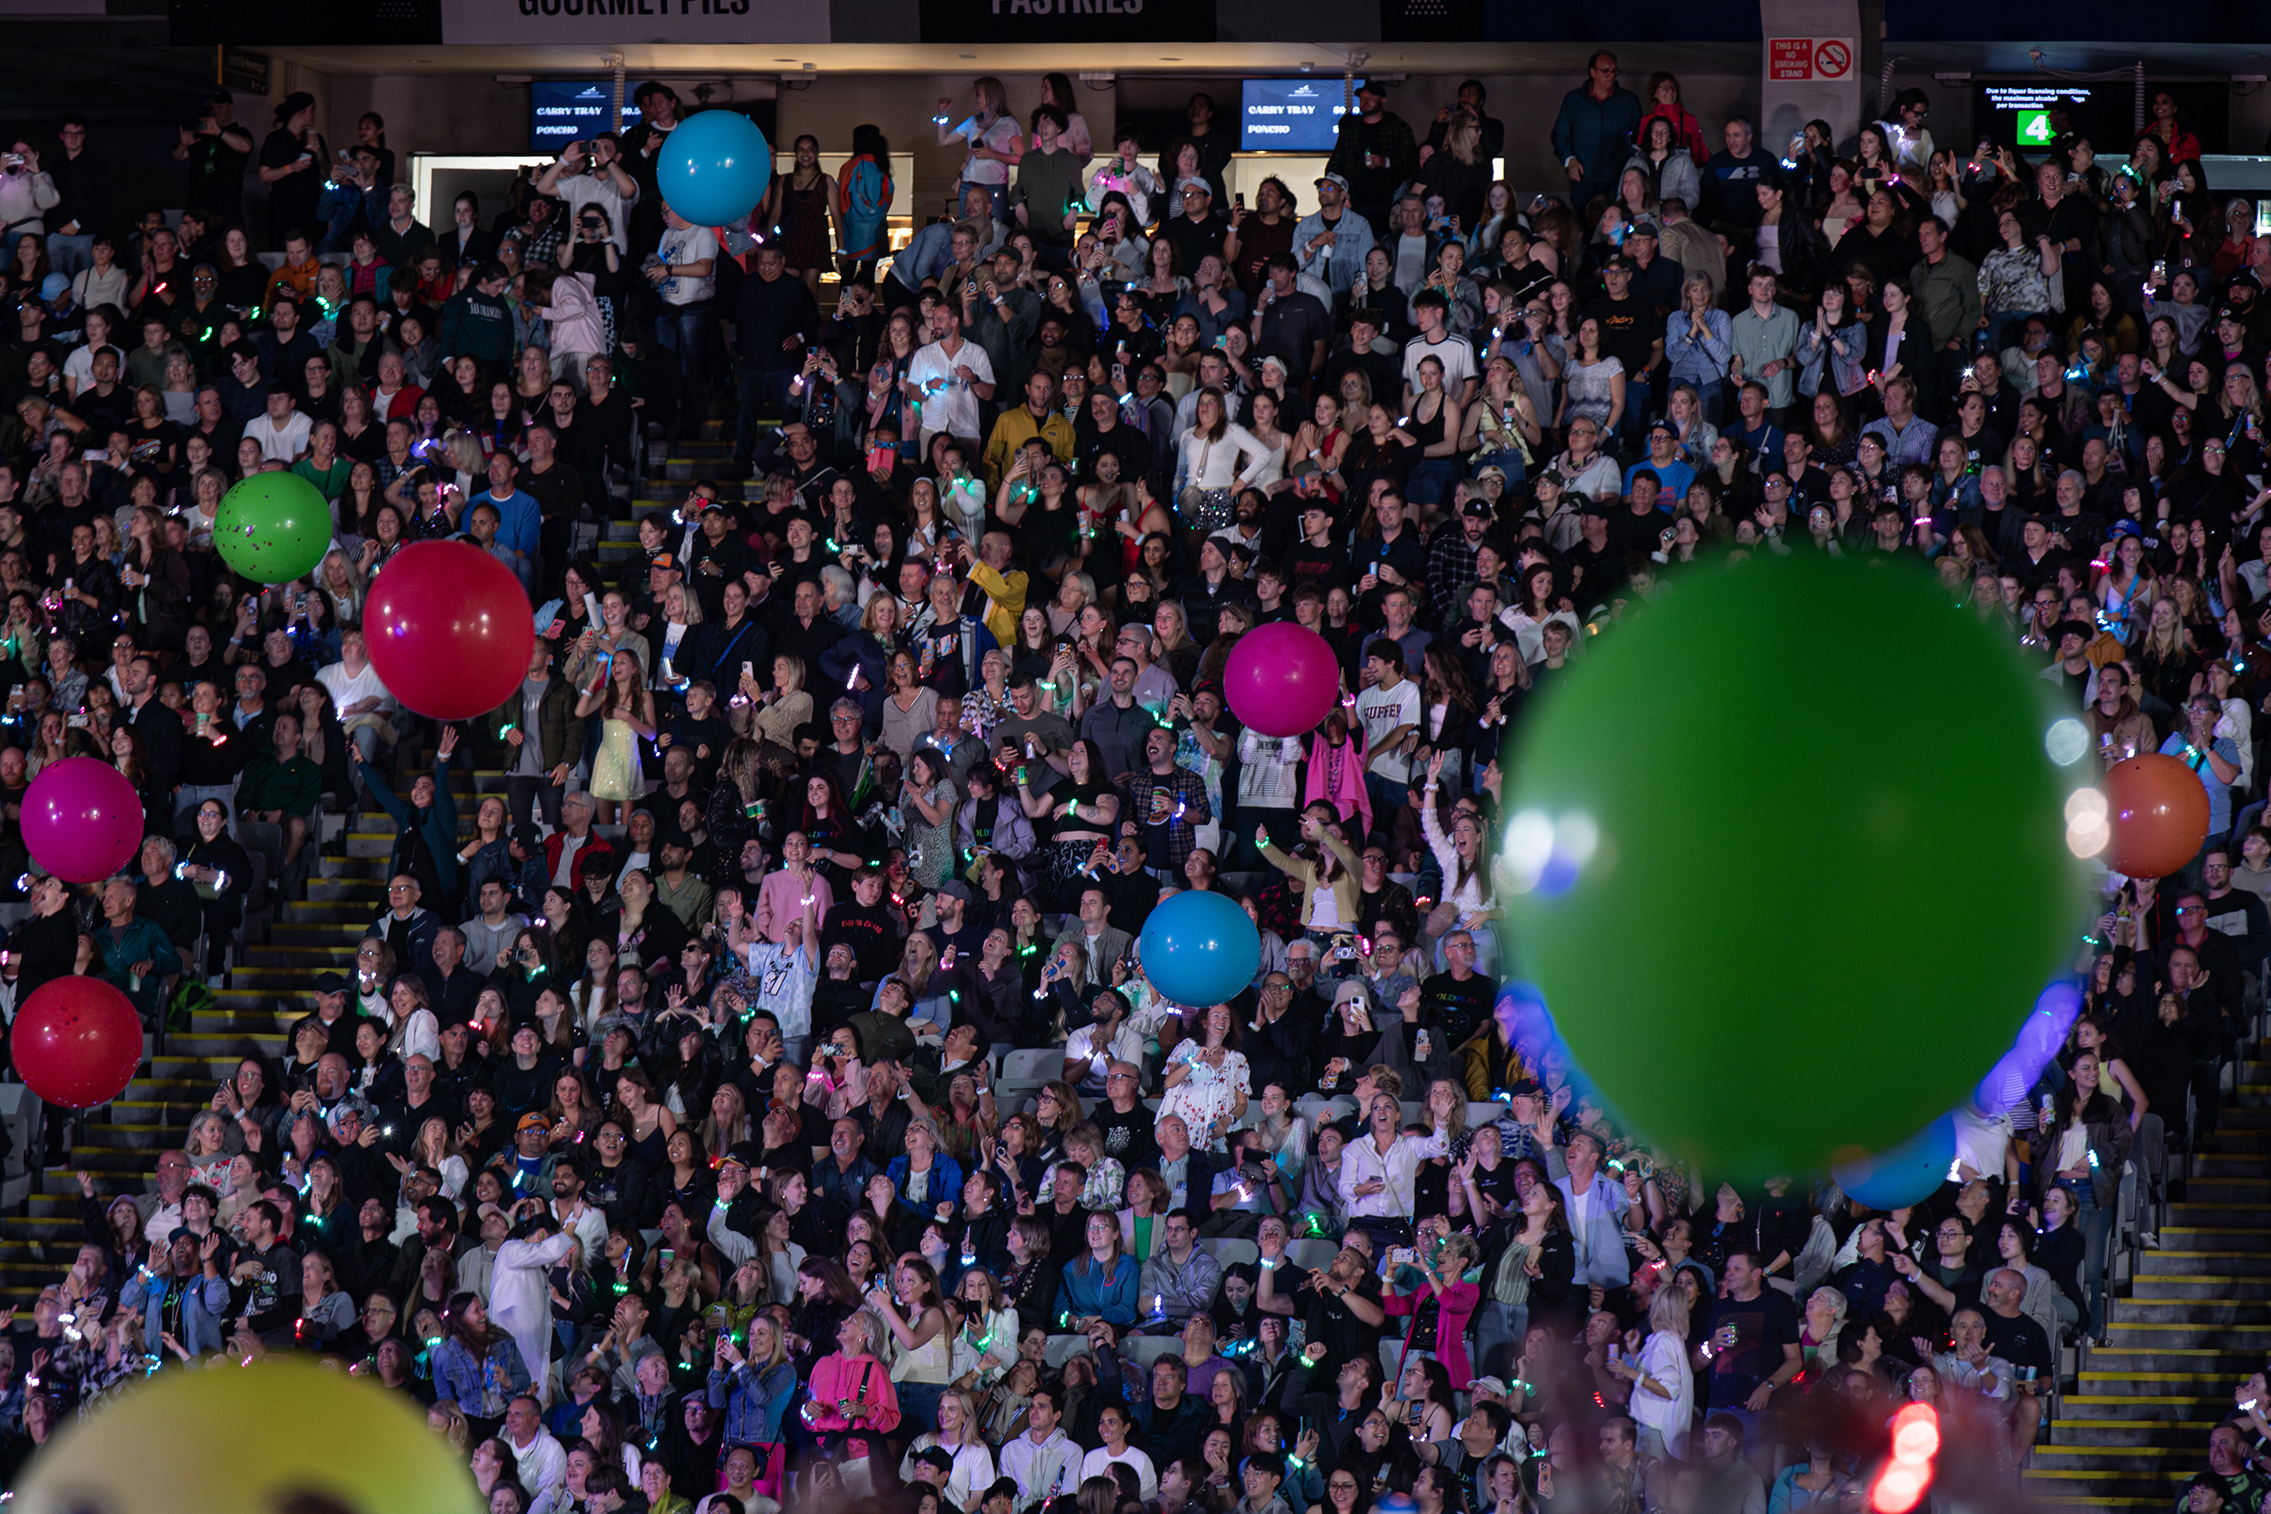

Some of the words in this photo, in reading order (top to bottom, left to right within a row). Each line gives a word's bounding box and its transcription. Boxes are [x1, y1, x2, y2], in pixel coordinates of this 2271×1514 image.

[1775, 42, 1791, 50] THIS
[1793, 42, 1801, 50] IS
[1802, 42, 1808, 50] A
[1785, 51, 1796, 59] NO
[1780, 70, 1803, 78] STAND
[1985, 87, 1999, 95] Due
[2008, 87, 2026, 96] liquor
[2027, 87, 2055, 96] licensing
[1247, 105, 1285, 115] CARRY
[1286, 105, 1315, 115] TRAY
[1996, 102, 2007, 110] per
[536, 106, 572, 116] CARRY
[573, 106, 603, 116] TRAY
[536, 125, 578, 135] PONCHO
[1247, 124, 1290, 134] PONCHO
[2025, 115, 2049, 141] 4
